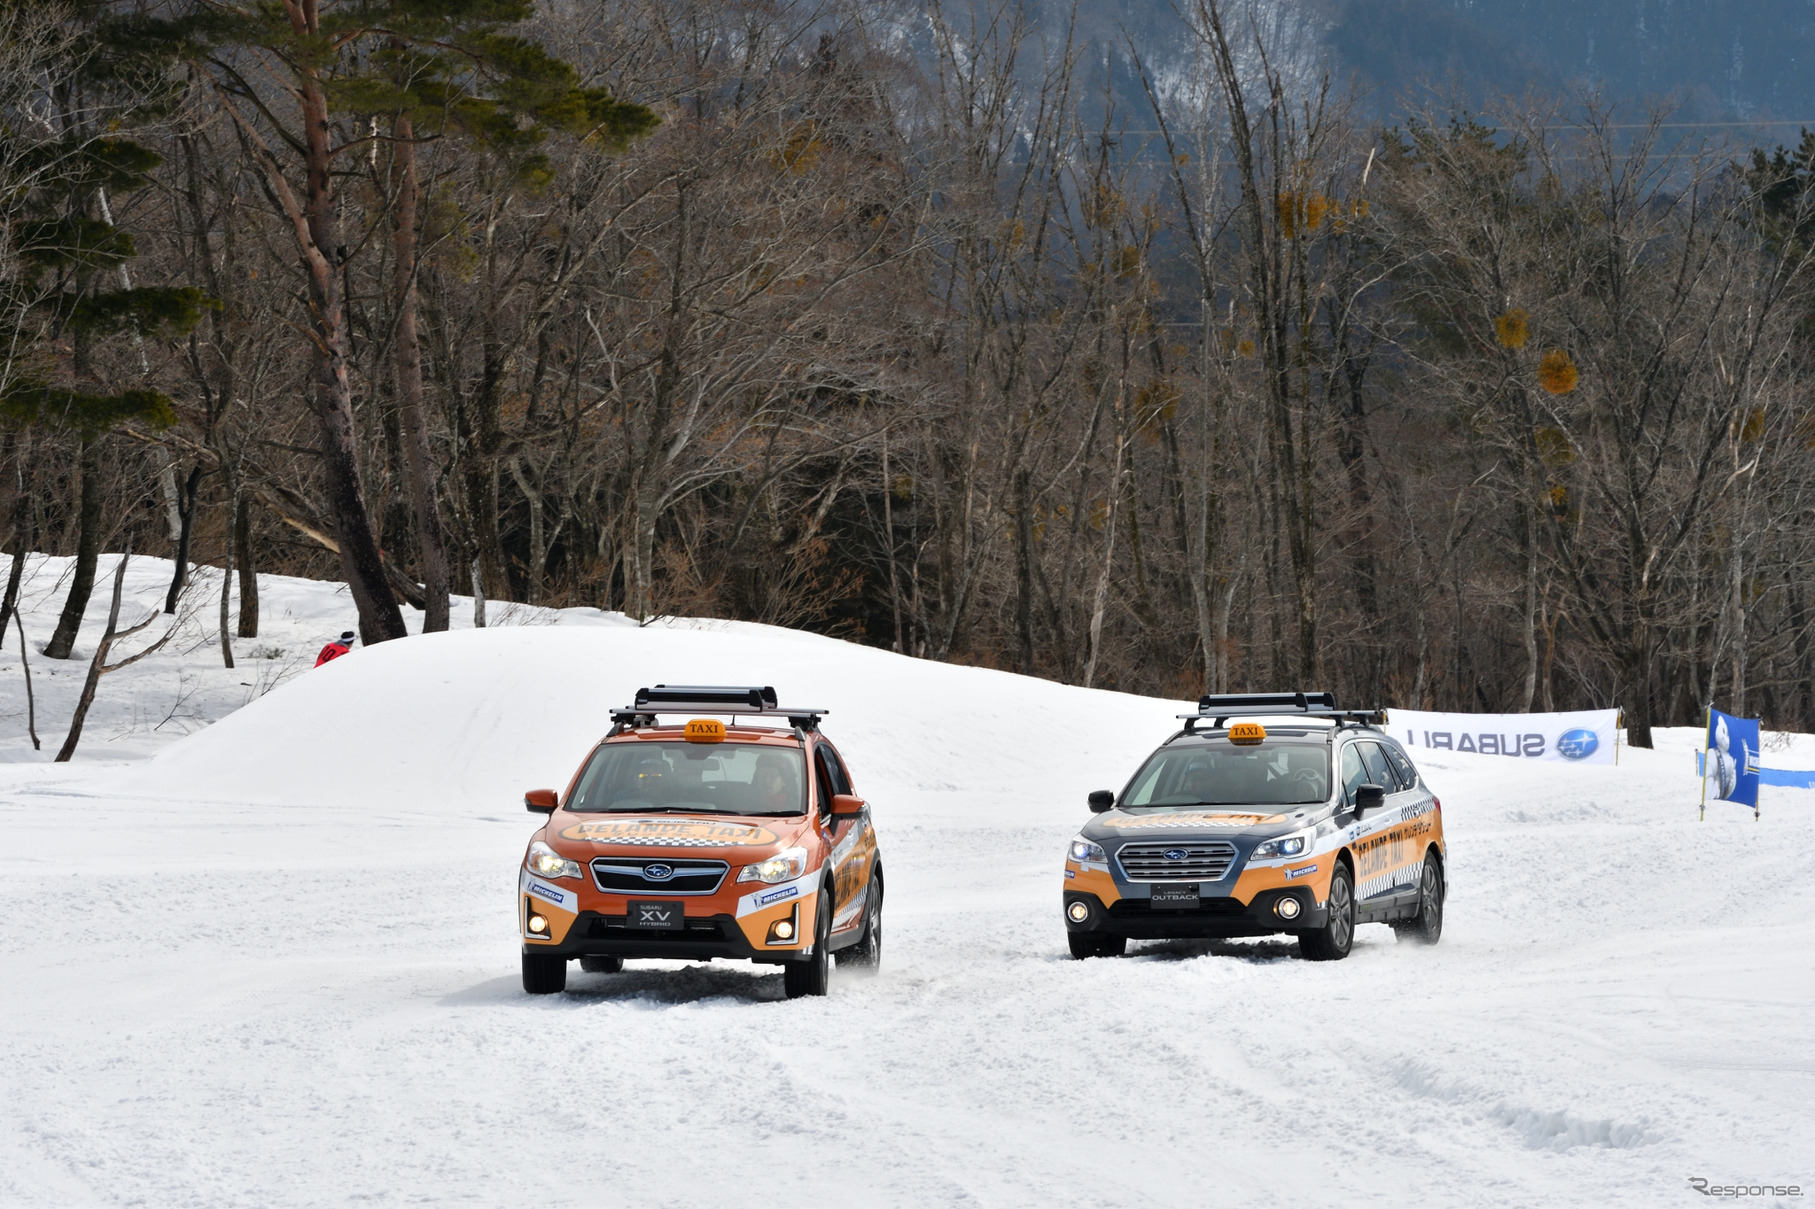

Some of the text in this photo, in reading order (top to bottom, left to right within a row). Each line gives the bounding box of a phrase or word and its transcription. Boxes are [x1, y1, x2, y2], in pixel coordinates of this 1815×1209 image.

[690, 724, 718, 733] TAXI
[1233, 727, 1258, 736] TAXI
[707, 825, 762, 839] TAXI
[1389, 830, 1403, 866] TAXI
[533, 886, 563, 902] MICHELIN
[763, 888, 797, 903] MICHELIN
[640, 911, 671, 921] XV
